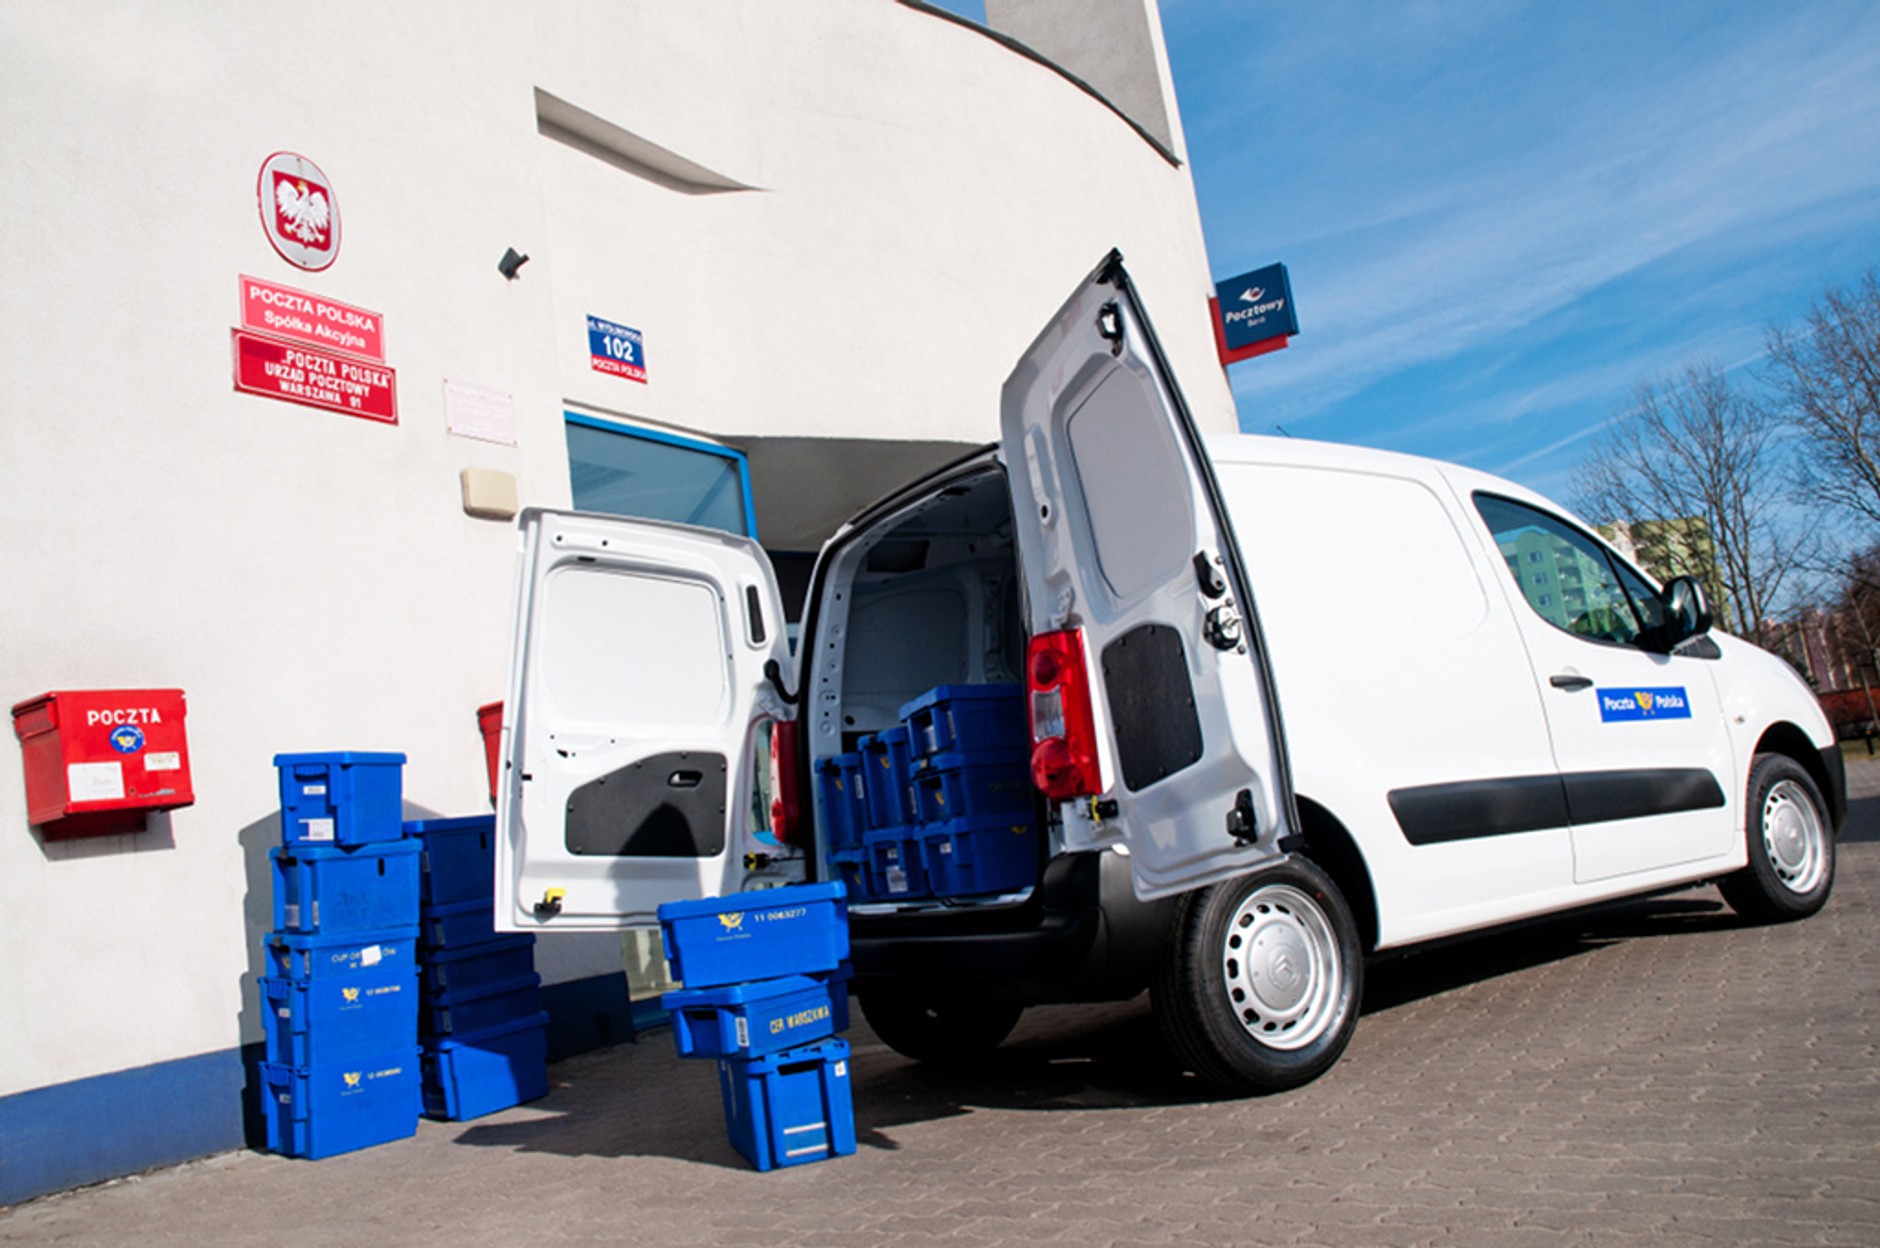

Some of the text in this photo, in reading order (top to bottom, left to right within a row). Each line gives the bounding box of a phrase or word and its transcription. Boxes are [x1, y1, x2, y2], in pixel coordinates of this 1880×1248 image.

[250, 286, 376, 332] POCZTA POLSKA
[1225, 298, 1285, 324] Pocztowy
[264, 309, 366, 348] Spółka Akcyjna
[603, 335, 634, 362] 102
[279, 380, 342, 404] WARSZAWA
[308, 372, 370, 397] POCZTOWY
[1604, 694, 1685, 711] Poczta Polska
[87, 708, 162, 726] POCZTA
